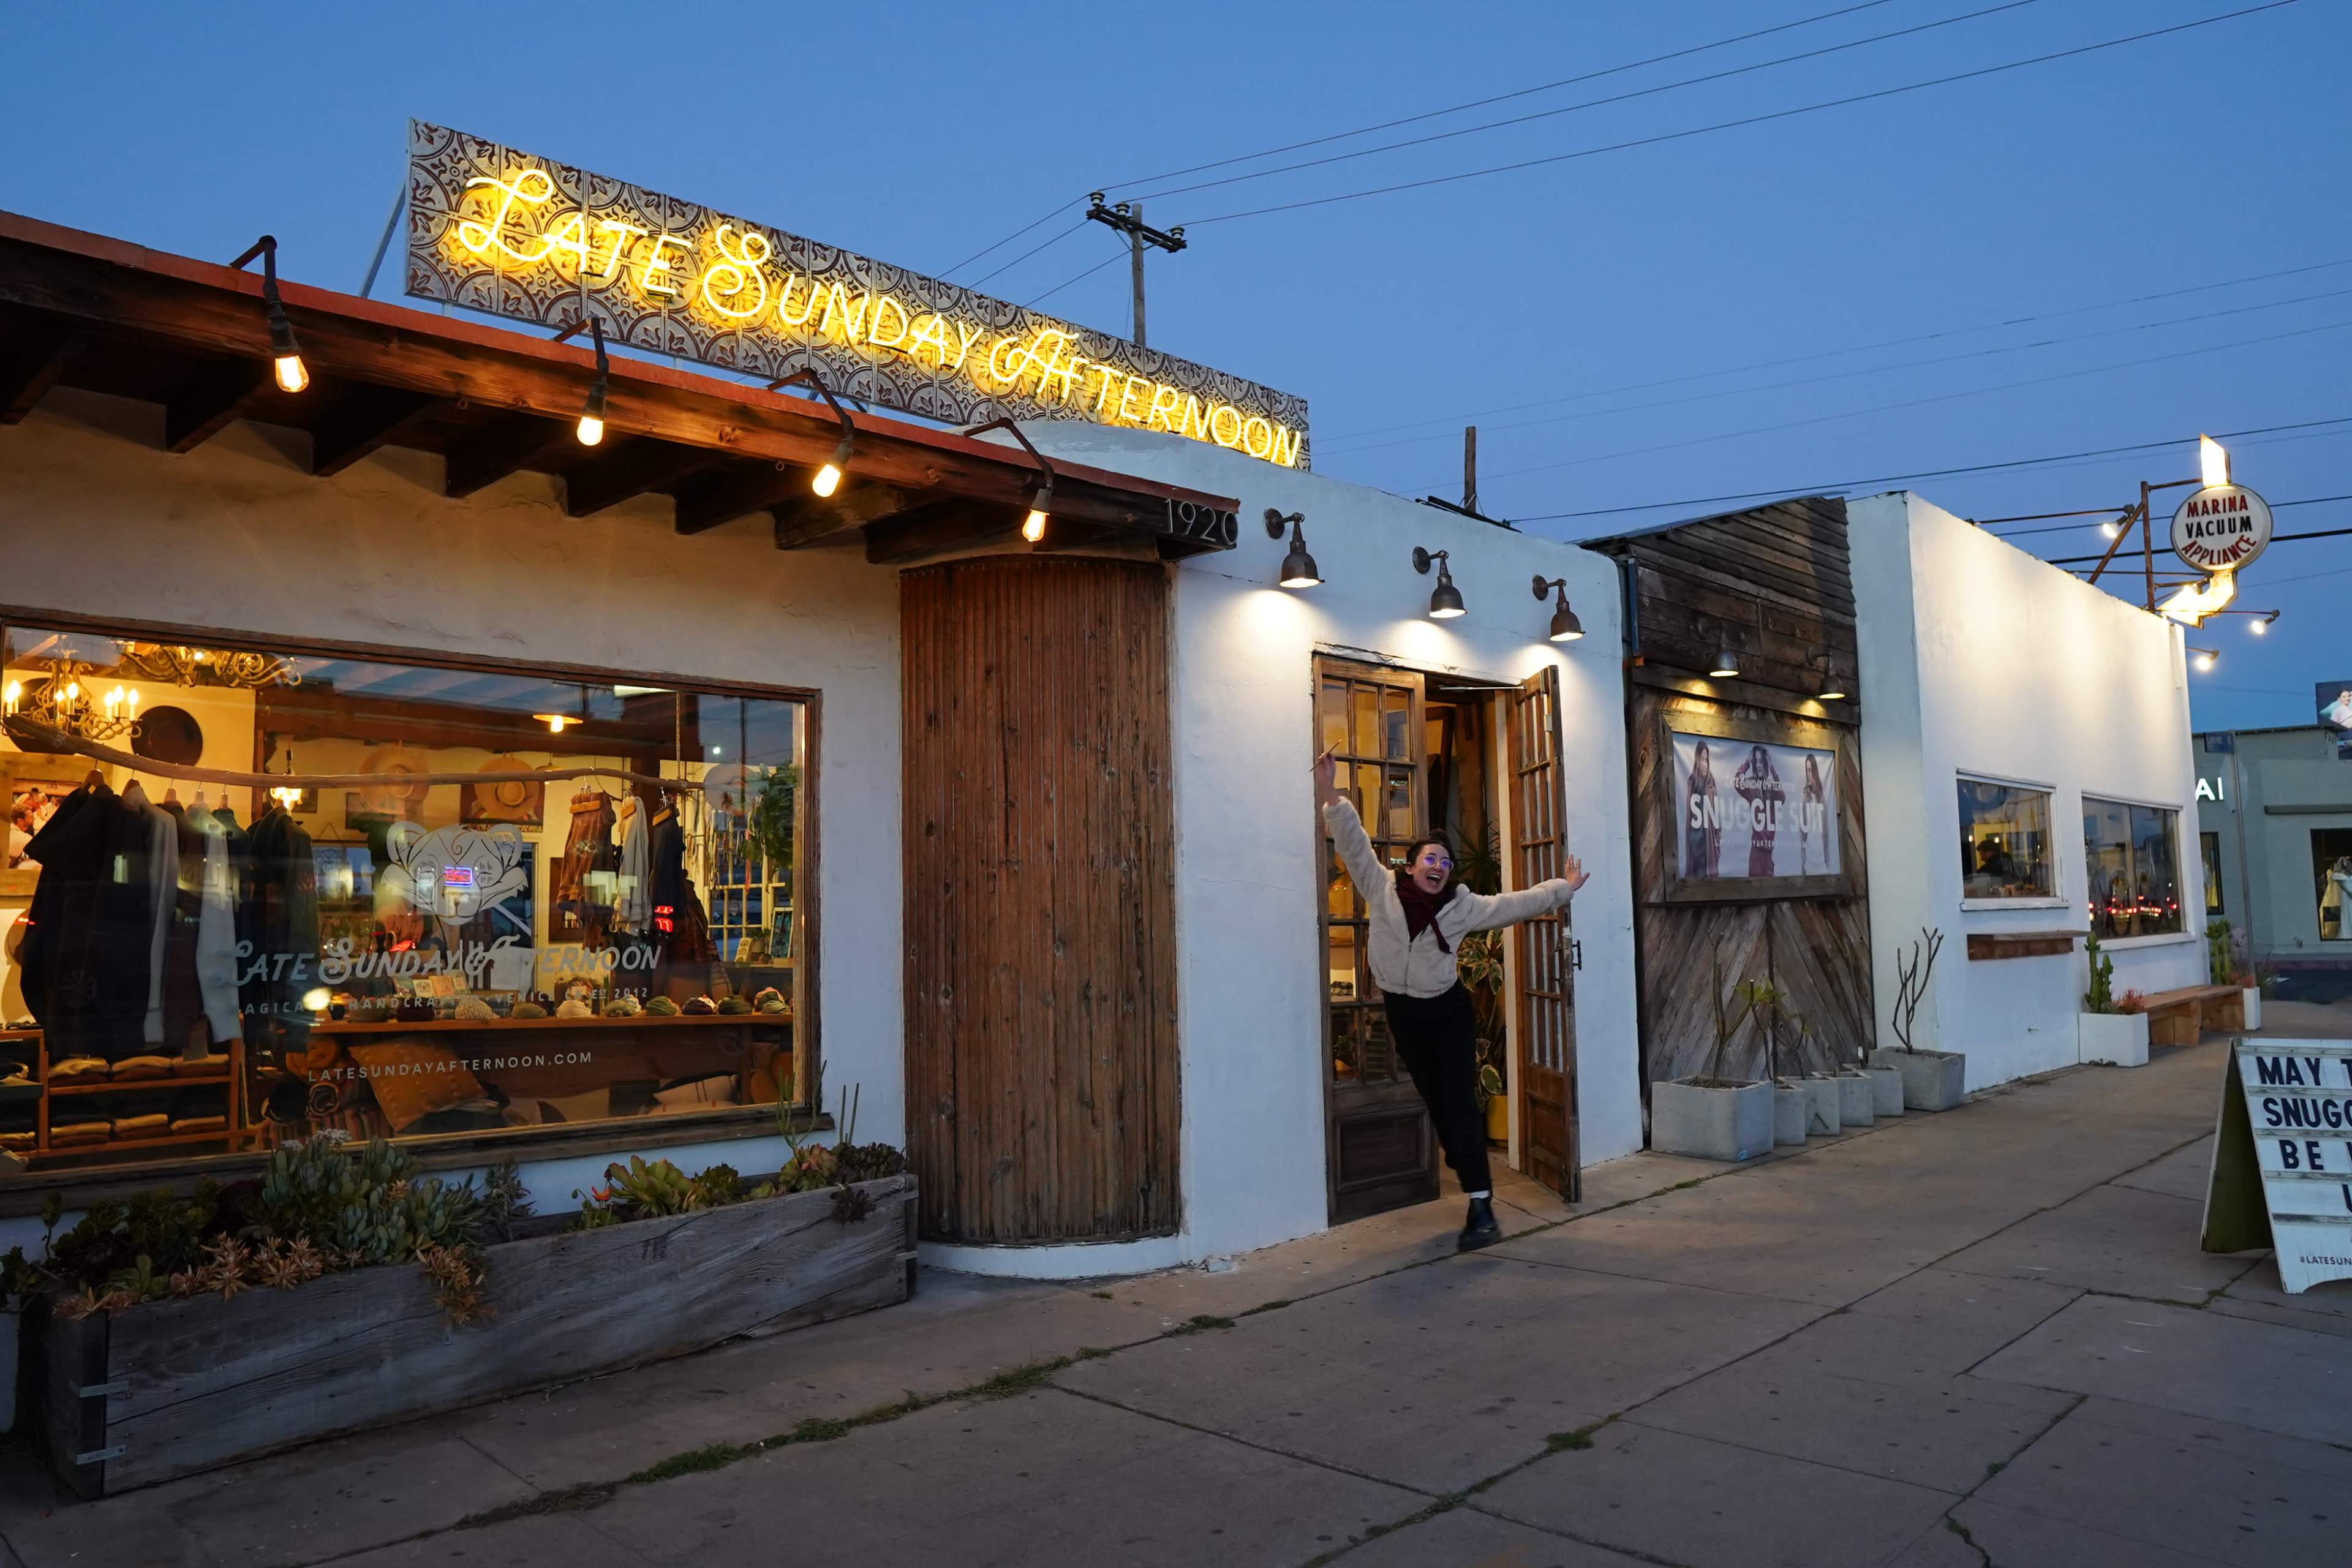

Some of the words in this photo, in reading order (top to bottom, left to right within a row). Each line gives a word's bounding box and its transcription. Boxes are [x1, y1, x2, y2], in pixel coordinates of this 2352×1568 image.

[458, 168, 693, 295] LATE
[703, 224, 984, 369] SUNDAY
[989, 328, 1302, 467] AFTERNOON
[2187, 494, 2248, 518] MARINA
[1165, 498, 1238, 545] 1920
[2186, 516, 2252, 538] VACUUM
[2181, 535, 2256, 565] APPLIANCE
[1690, 793, 1784, 832] SNUGGLE
[1790, 800, 1824, 834] SUIT
[318, 937, 462, 985] SUNDAY
[614, 987, 647, 999] 2012
[309, 1052, 592, 1082] LATESUNDAYAFTERNOON.COM
[2256, 1056, 2321, 1087] MAY
[2279, 1139, 2324, 1170] BE
[2300, 1254, 2352, 1266] #LATESUN
